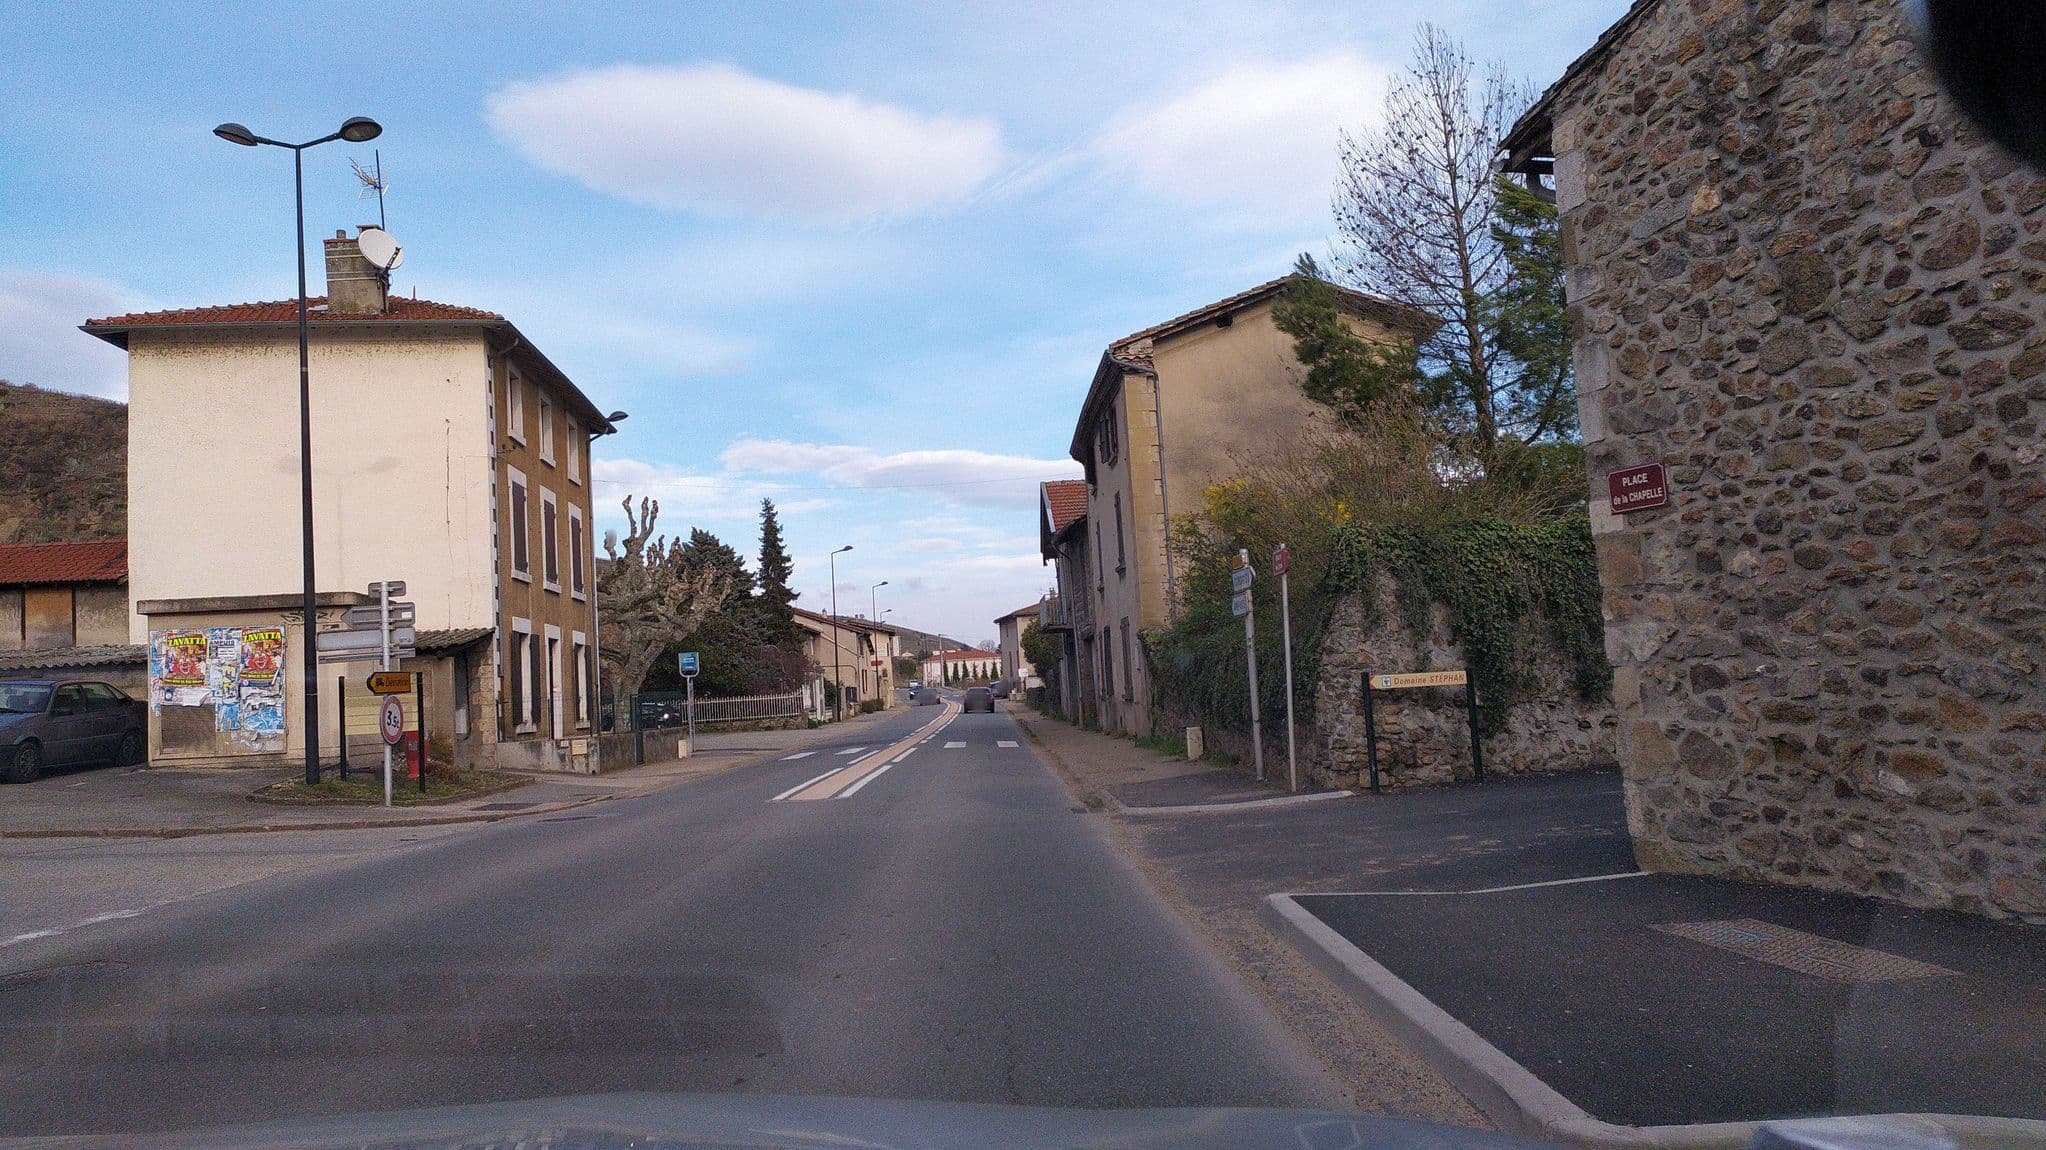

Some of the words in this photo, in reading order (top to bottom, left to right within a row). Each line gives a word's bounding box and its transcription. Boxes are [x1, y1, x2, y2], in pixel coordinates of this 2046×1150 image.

[1622, 473, 1648, 487] PLACE
[1613, 496, 1621, 505] de
[1622, 495, 1628, 503] la
[1629, 487, 1663, 502] CHAPELLE
[167, 637, 206, 647] ZAVATTA
[243, 631, 281, 643] ZAVATTA
[1393, 677, 1427, 685] Domaine
